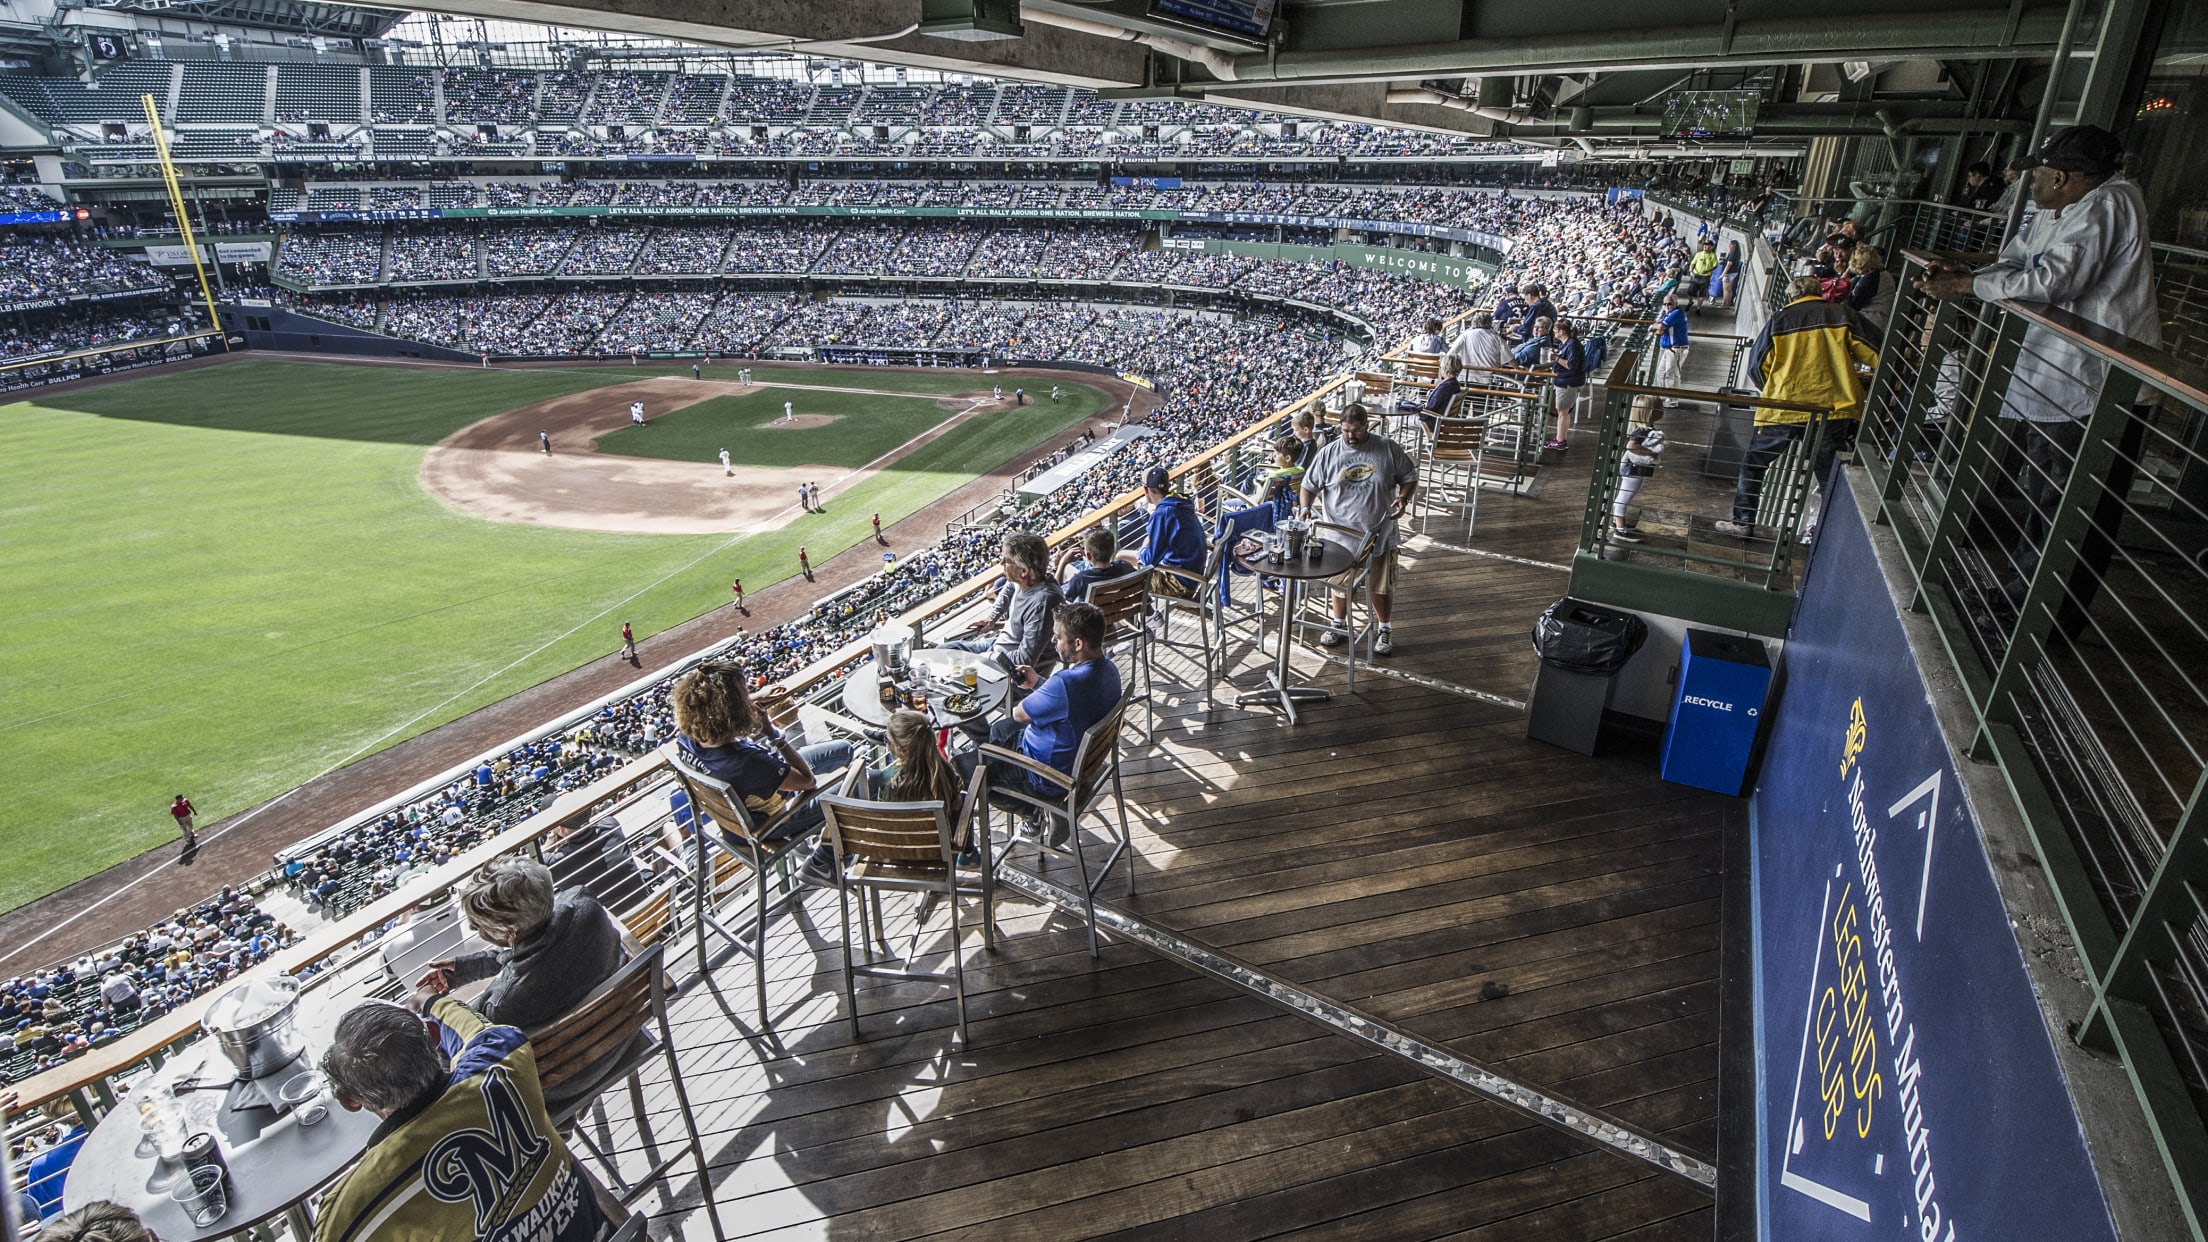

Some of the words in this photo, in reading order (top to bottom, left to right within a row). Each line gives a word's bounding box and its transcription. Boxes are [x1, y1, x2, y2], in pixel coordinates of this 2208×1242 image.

[1141, 178, 1158, 186] PNC
[61, 210, 70, 221] 2
[1364, 253, 1437, 273] WELCOME
[1444, 265, 1460, 278] TO
[0, 303, 12, 313] LB
[13, 299, 57, 312] NETWORK
[132, 360, 150, 369] Health
[166, 353, 193, 364] BULLPEN
[8, 383, 30, 393] Health
[30, 380, 45, 389] Care
[48, 373, 81, 385] BULLPEN
[1684, 695, 1734, 712] RECYCLE
[1848, 766, 1904, 1046] Northwestern
[1833, 882, 1882, 1139] LEGENDS
[1816, 986, 1845, 1140] CLUB
